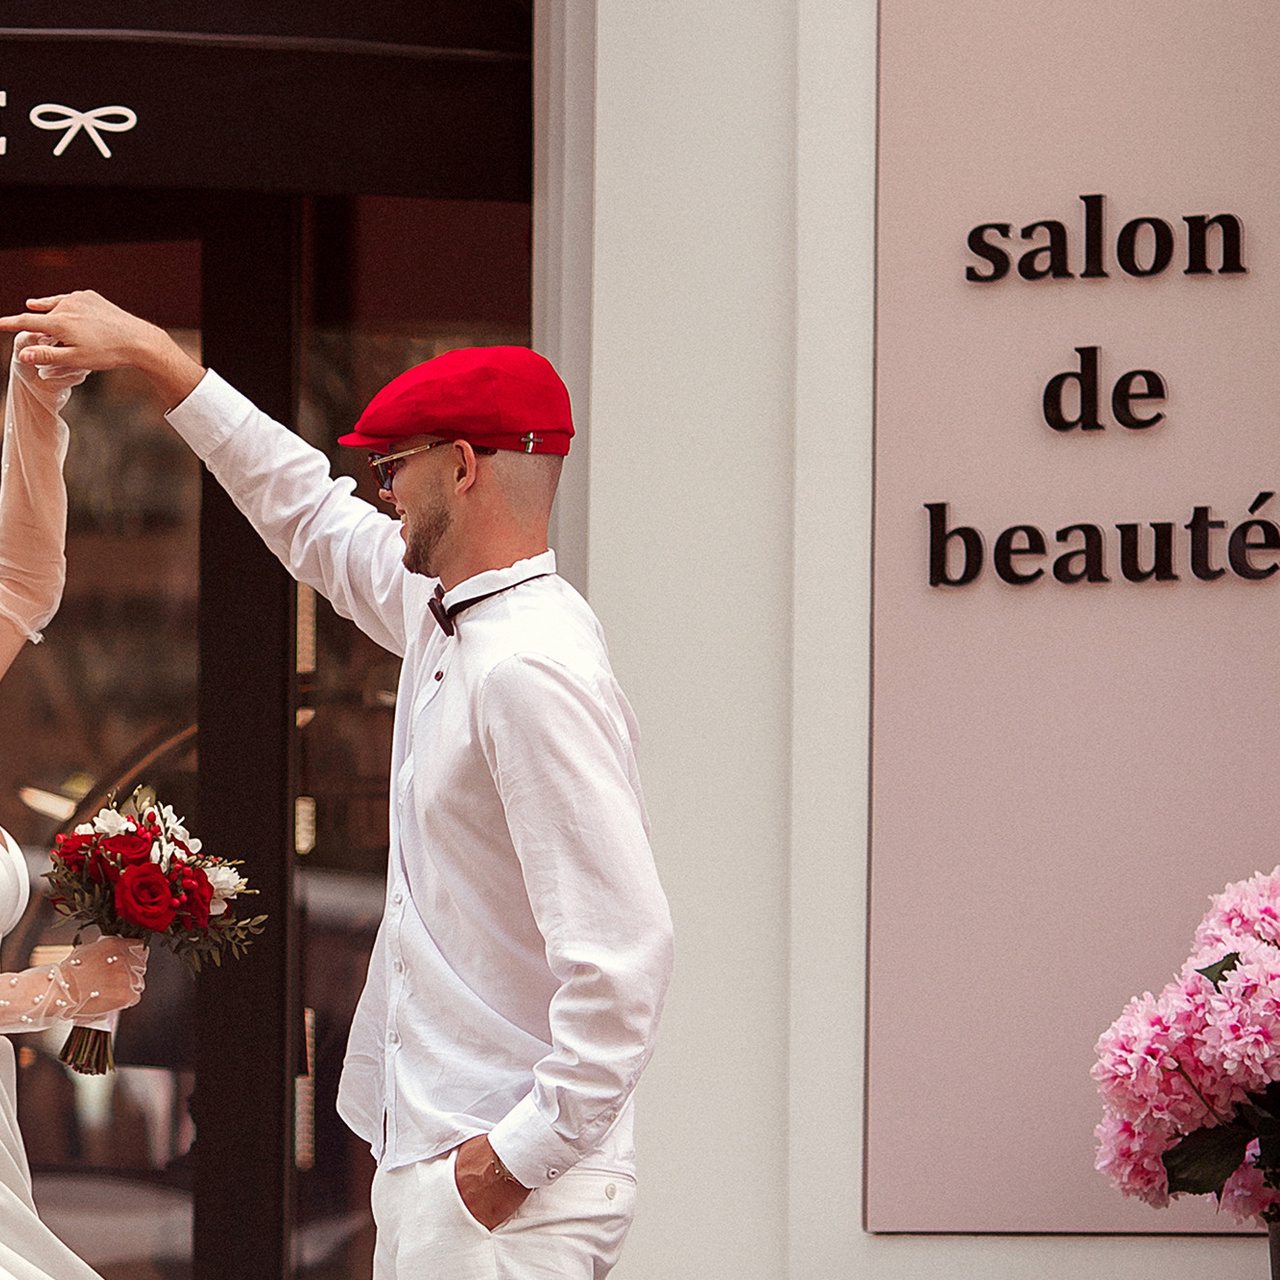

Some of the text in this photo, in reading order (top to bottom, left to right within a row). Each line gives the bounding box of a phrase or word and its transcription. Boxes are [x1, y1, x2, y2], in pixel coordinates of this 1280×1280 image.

[965, 194, 1250, 283] salon
[1042, 345, 1167, 432] de
[923, 492, 1280, 587] beauté
